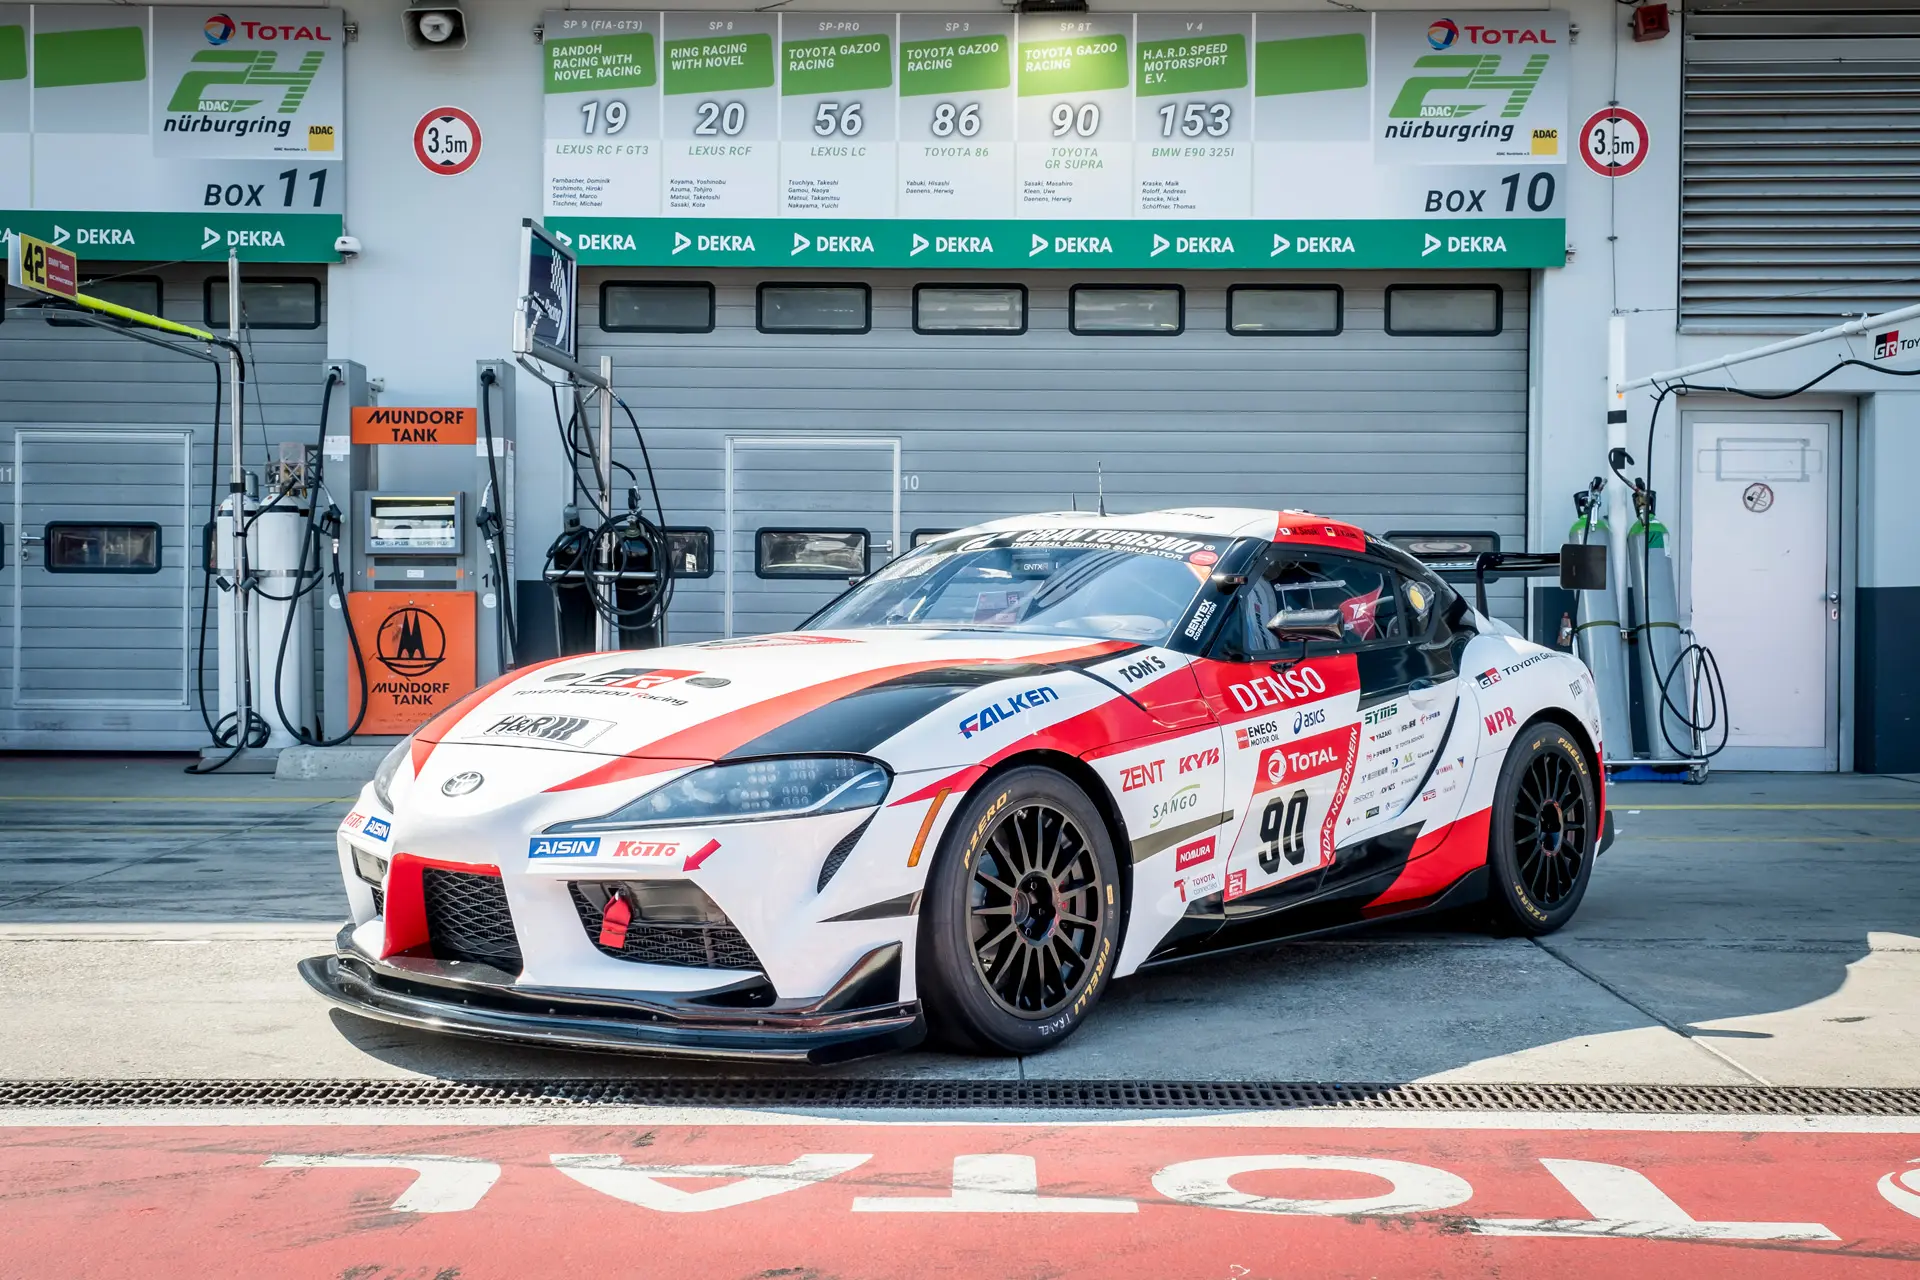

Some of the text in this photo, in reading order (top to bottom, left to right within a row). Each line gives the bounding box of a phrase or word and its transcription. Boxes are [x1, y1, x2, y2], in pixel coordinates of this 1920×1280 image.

[241, 21, 332, 42] TOTAL
[563, 20, 643, 32] SP 9 (FIA-GT3)
[709, 21, 734, 31] SP 8
[819, 21, 860, 31] SP-PRO
[945, 22, 970, 32] SP 3
[1060, 22, 1092, 32] SP 8T
[1186, 22, 1204, 32] V 4
[1464, 25, 1557, 45] TOTAL
[552, 44, 603, 57] BANDOH
[670, 43, 748, 58] RING RACING
[788, 42, 882, 59] TOYOTA GAZOO
[907, 43, 999, 60] TOYOTA GAZOO
[1025, 43, 1118, 60] TOYOTA GAZOO
[1143, 43, 1229, 61] H.A.R.D.SPEED
[553, 54, 633, 69] RACING WITH
[671, 55, 744, 71] WITH NOVEL
[789, 58, 835, 71] RACING
[907, 59, 953, 72] RACING
[1026, 59, 1071, 72] RACING
[1144, 55, 1229, 73] MOTORSPORT
[554, 65, 642, 81] NOVEL RACING
[1145, 73, 1168, 85] E.V.
[198, 100, 230, 112] ADAC
[1420, 106, 1452, 117] ADAC
[580, 99, 629, 135] 19
[694, 101, 746, 136] 20
[813, 102, 863, 137] 56
[930, 102, 982, 137] 86
[1051, 102, 1100, 137] 90
[1158, 102, 1232, 137] 153
[163, 115, 292, 138] nürburgring
[308, 126, 334, 136] ADAC
[1384, 119, 1515, 142] nürburgring
[1533, 129, 1558, 139] ADAC
[556, 145, 649, 155] LEXUS RC F GT3
[688, 146, 752, 156] LEXUS RCF
[811, 146, 866, 156] LEXUS LC
[924, 147, 989, 157] TOYOTA 86
[1051, 147, 1099, 157] TOYOTA
[1151, 147, 1180, 157] BMW
[1184, 147, 1206, 157] E90
[1044, 159, 1104, 170] GR SUPRA
[204, 168, 328, 208] BOX 11
[1425, 171, 1556, 213] BOX 10
[77, 228, 135, 245] DEKRA
[227, 230, 285, 247] DEKRA
[578, 234, 637, 251] DEKRA
[697, 235, 756, 252] DEKRA
[816, 236, 875, 253] DEKRA
[935, 237, 994, 253] DEKRA
[1054, 237, 1113, 253] DEKRA
[1176, 237, 1236, 253] DEKRA
[1296, 237, 1356, 253] DEKRA
[1447, 236, 1507, 253] DEKRA
[24, 242, 45, 285] 42
[1875, 338, 1920, 358] GR TOY
[366, 410, 464, 425] MUNDORF
[391, 428, 438, 442] TANK
[902, 475, 920, 491] 10
[1016, 528, 1087, 542] GRAN
[1011, 541, 1030, 549] THE
[1031, 541, 1065, 549] REAL
[1065, 541, 1111, 551] DRIVING
[1112, 543, 1184, 561] SIMULATOR
[1184, 599, 1213, 639] GENTEX
[1192, 603, 1218, 641] CORPORATION
[1118, 656, 1166, 684] TOM'S
[1479, 674, 1502, 689] GR
[1502, 656, 1541, 676] TOYOTA
[371, 682, 450, 694] MUNDORF
[576, 674, 679, 689] GR
[1228, 666, 1327, 712] DENSO
[392, 694, 433, 705] TANK
[512, 688, 689, 707] TOYOTA GAZOO Racing
[958, 686, 1060, 740] FALKEN
[1484, 706, 1517, 736] NPR
[486, 715, 552, 735] H&R
[1247, 720, 1278, 738] ENEOS
[1250, 734, 1270, 748] MOTOR
[1271, 733, 1280, 742] OIL
[1178, 747, 1220, 774] KYB
[1288, 746, 1338, 773] TOTAL
[1558, 736, 1588, 776] PIRELLI
[1119, 759, 1166, 792] ZENT
[1322, 822, 1333, 861] ADAC
[1331, 727, 1358, 816] NORDRHEIN
[1152, 793, 1197, 819] SANGO
[366, 820, 390, 838] AISIN
[1257, 788, 1309, 875] 90
[532, 841, 598, 855] AISIN
[1180, 845, 1211, 864] NOMURA
[1192, 873, 1216, 886] TOYOTA
[1074, 937, 1111, 1015] PIRELLI
